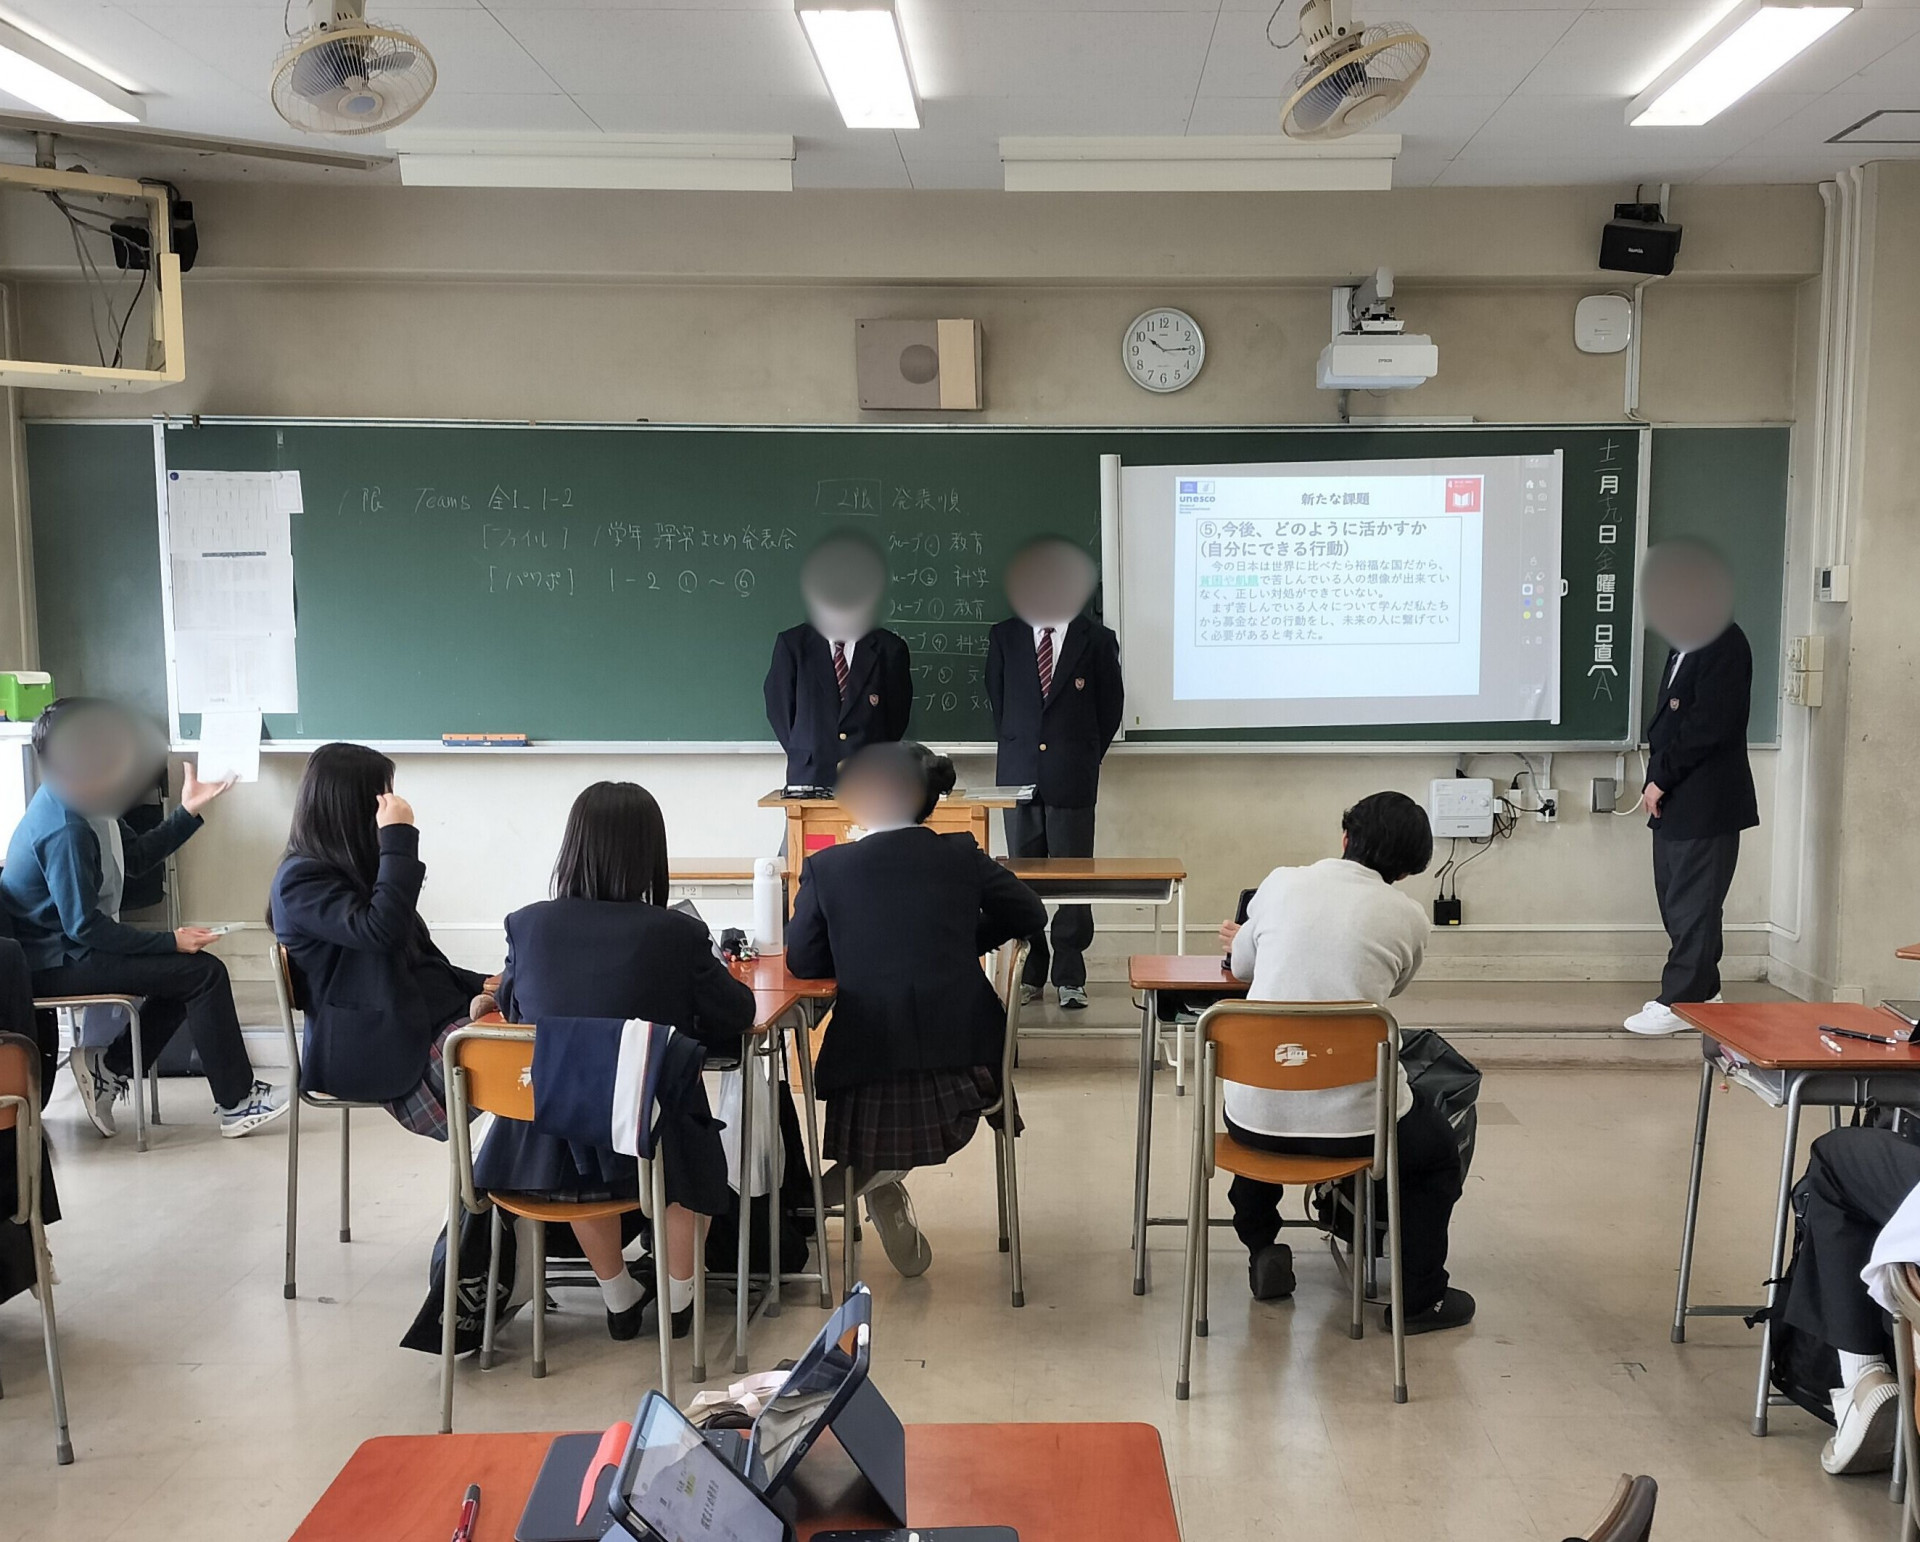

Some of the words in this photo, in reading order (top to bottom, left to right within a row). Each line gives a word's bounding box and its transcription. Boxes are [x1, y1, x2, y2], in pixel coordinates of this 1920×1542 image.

[1147, 321, 1155, 332] 11
[1160, 317, 1169, 328] 12
[1176, 321, 1179, 332] 1
[1136, 331, 1146, 342] 10
[1184, 331, 1191, 341] 2
[1132, 345, 1139, 356] 9
[1188, 345, 1196, 355] 3
[1136, 360, 1144, 370] 8
[1183, 359, 1190, 369] 4
[1147, 370, 1154, 380] 7
[1160, 373, 1167, 383] 6
[1174, 369, 1181, 380] 5
[414, 486, 471, 514] Teams
[1301, 493, 1370, 506] 新たな課題
